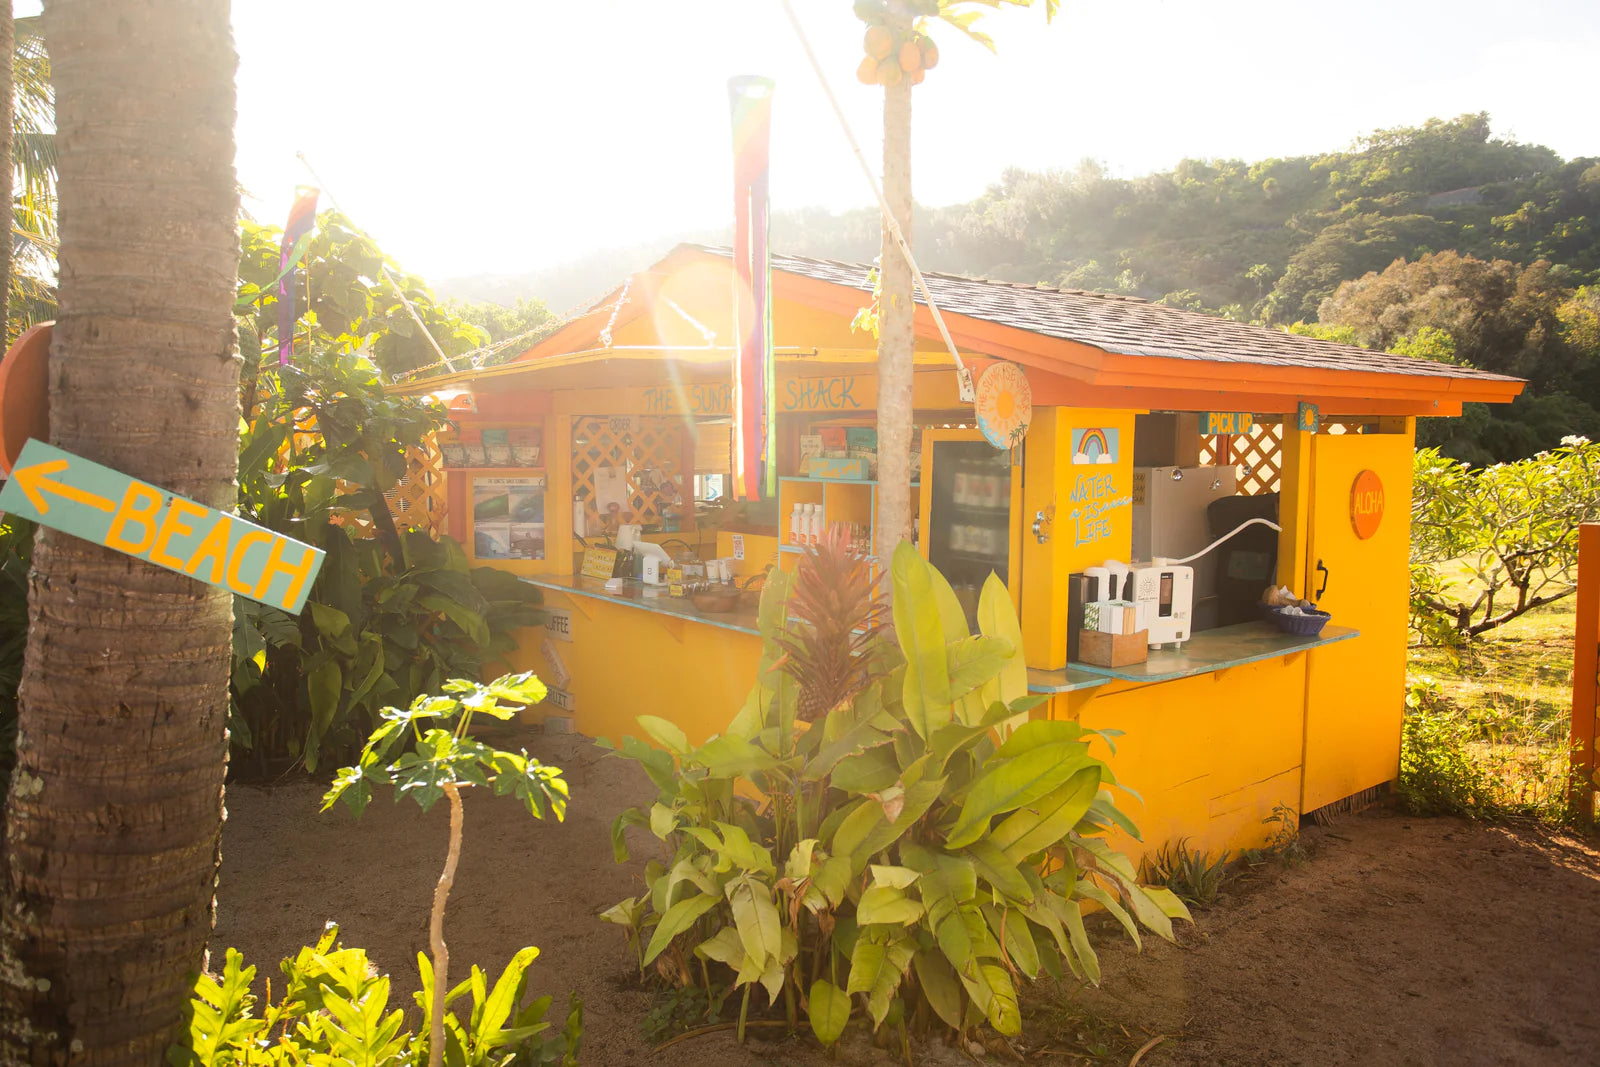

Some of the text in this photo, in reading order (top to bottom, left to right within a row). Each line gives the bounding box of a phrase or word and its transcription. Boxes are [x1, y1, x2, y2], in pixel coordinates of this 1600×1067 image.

[643, 387, 673, 412] THE
[783, 377, 863, 410] SHACK
[1208, 411, 1254, 434] PICK UP
[1069, 471, 1118, 504] WATER
[1354, 489, 1384, 515] ALOHA
[1084, 501, 1100, 521] IS
[103, 480, 317, 610] BEACH
[1073, 516, 1113, 549] LIFE
[547, 687, 568, 708] RUIT
